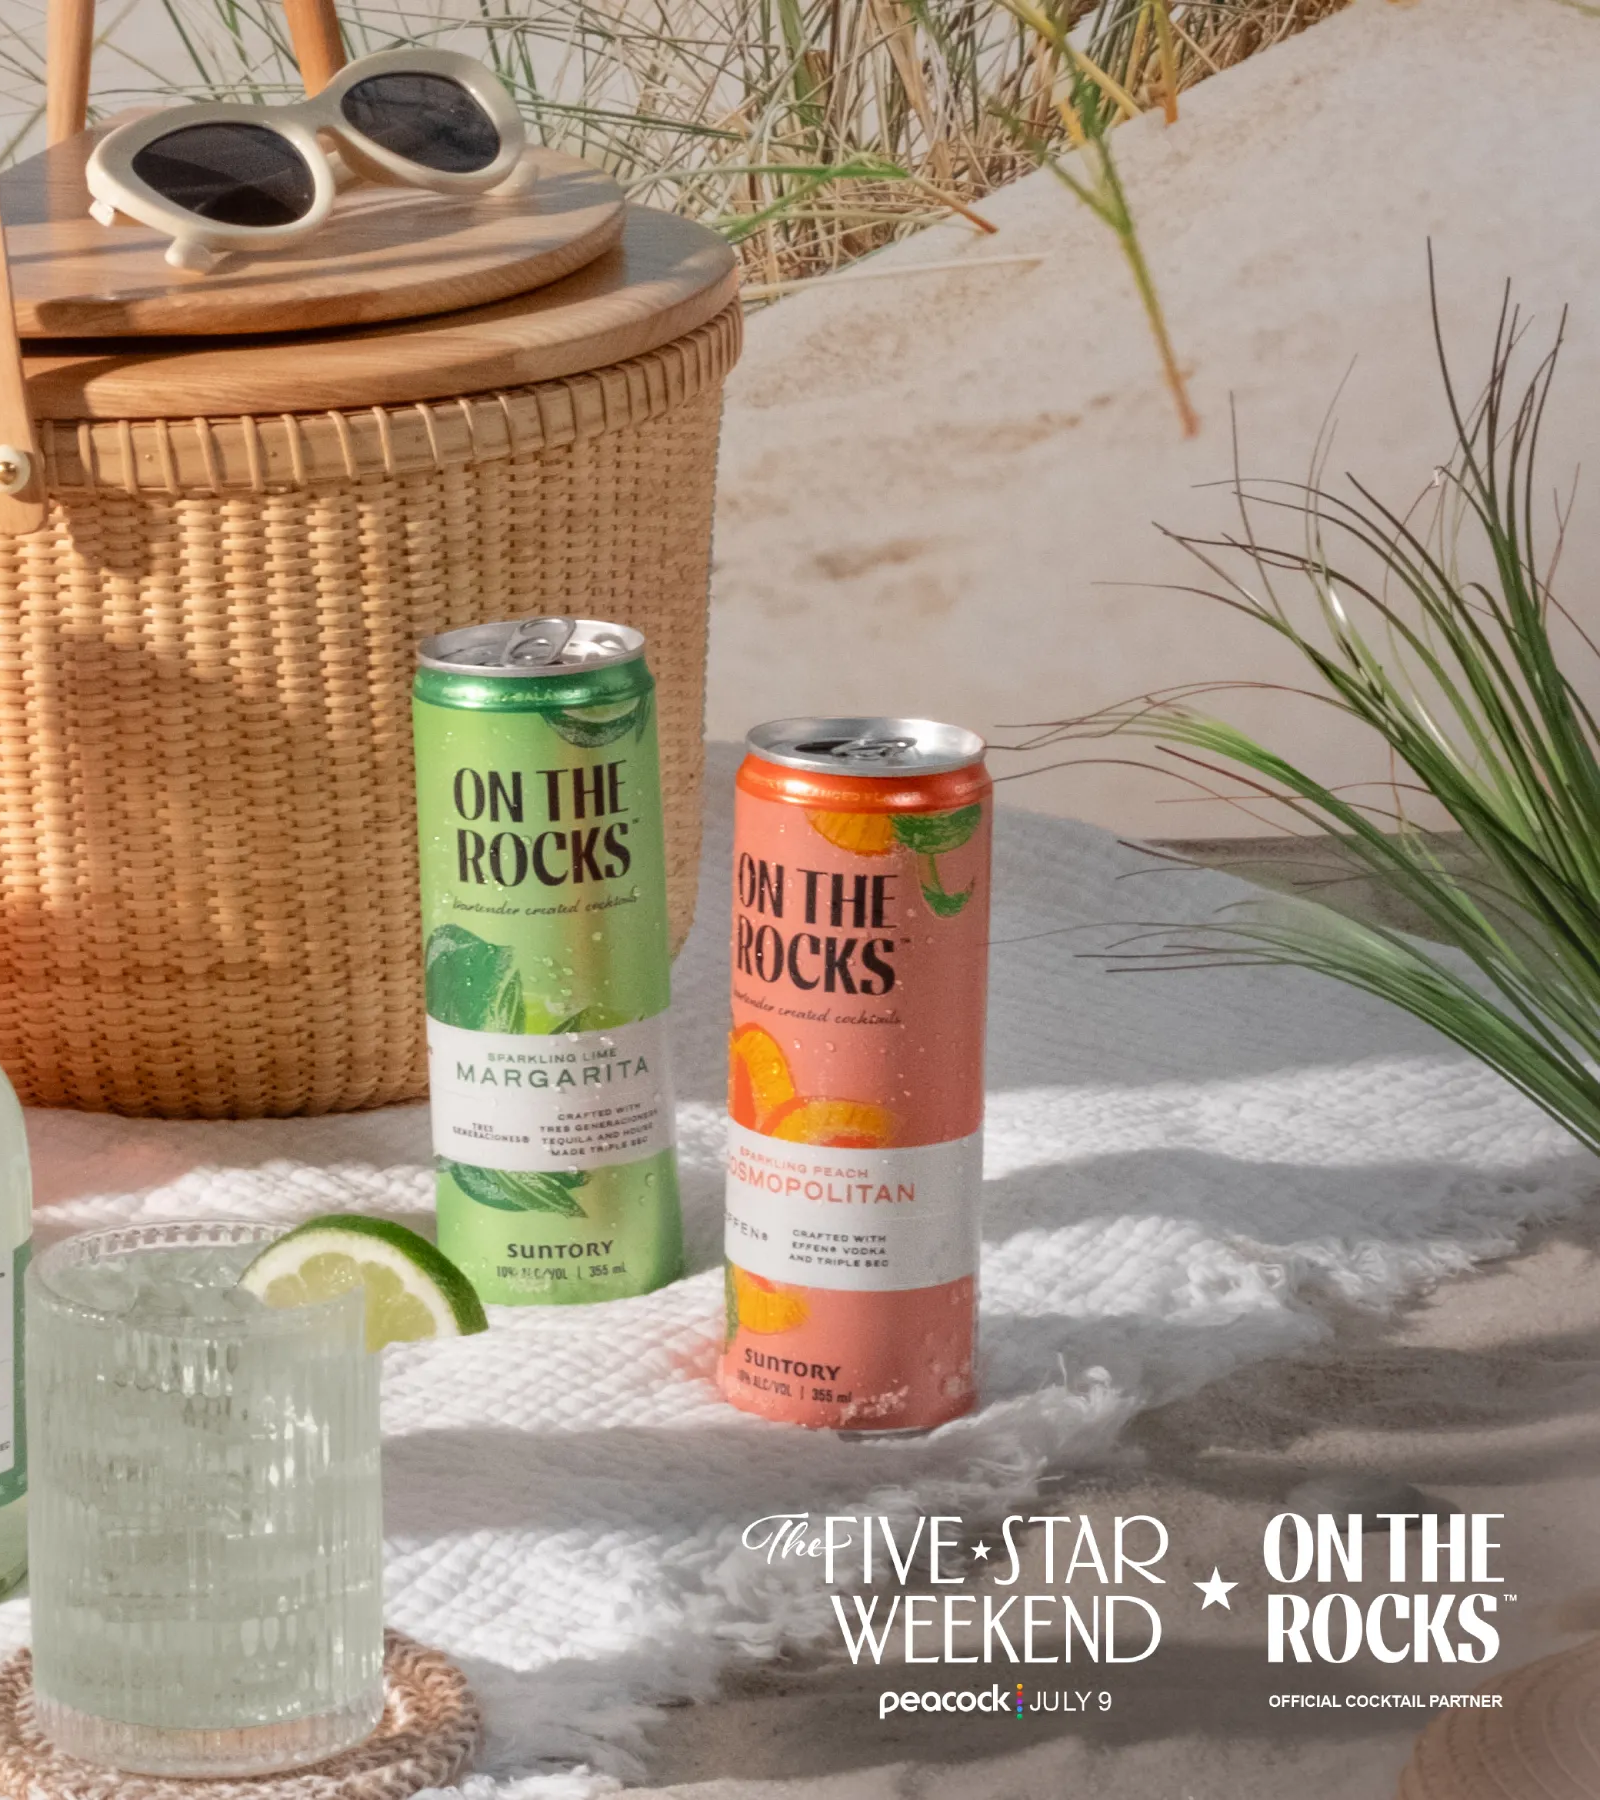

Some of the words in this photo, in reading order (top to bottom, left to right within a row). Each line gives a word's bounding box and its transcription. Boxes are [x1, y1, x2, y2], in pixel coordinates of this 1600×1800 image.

[454, 767, 523, 823] ON
[536, 760, 629, 822] THE
[738, 852, 784, 918] ON
[796, 868, 899, 929] THE
[525, 899, 579, 916] created
[778, 1006, 832, 1024] created
[834, 1009, 902, 1026] cocktails
[488, 1051, 577, 1065] SPARKLING
[583, 1048, 617, 1062] LIME
[456, 1055, 650, 1088] MARGARITA
[557, 1107, 613, 1121] CRAFTED
[616, 1102, 641, 1115] WITH
[472, 1122, 494, 1133] TRES
[539, 1124, 571, 1134] TRES
[542, 1135, 593, 1146] TEQUILA
[597, 1130, 620, 1141] AND
[551, 1146, 586, 1157] MADE
[590, 1140, 629, 1154] TRIPLE
[631, 1136, 649, 1147] SEC
[739, 1146, 808, 1174] SPARKLING
[813, 1165, 869, 1179] PEACH
[728, 1156, 916, 1204] OSMOPOLITAN
[792, 1229, 849, 1243] CRAFTED
[853, 1234, 887, 1244] WITH
[842, 1246, 887, 1256] VODKA
[788, 1253, 813, 1264] AND
[817, 1256, 861, 1268] TRIPLE
[865, 1259, 889, 1268] SEC
[588, 1264, 610, 1278] 355
[811, 1387, 833, 1403] 355
